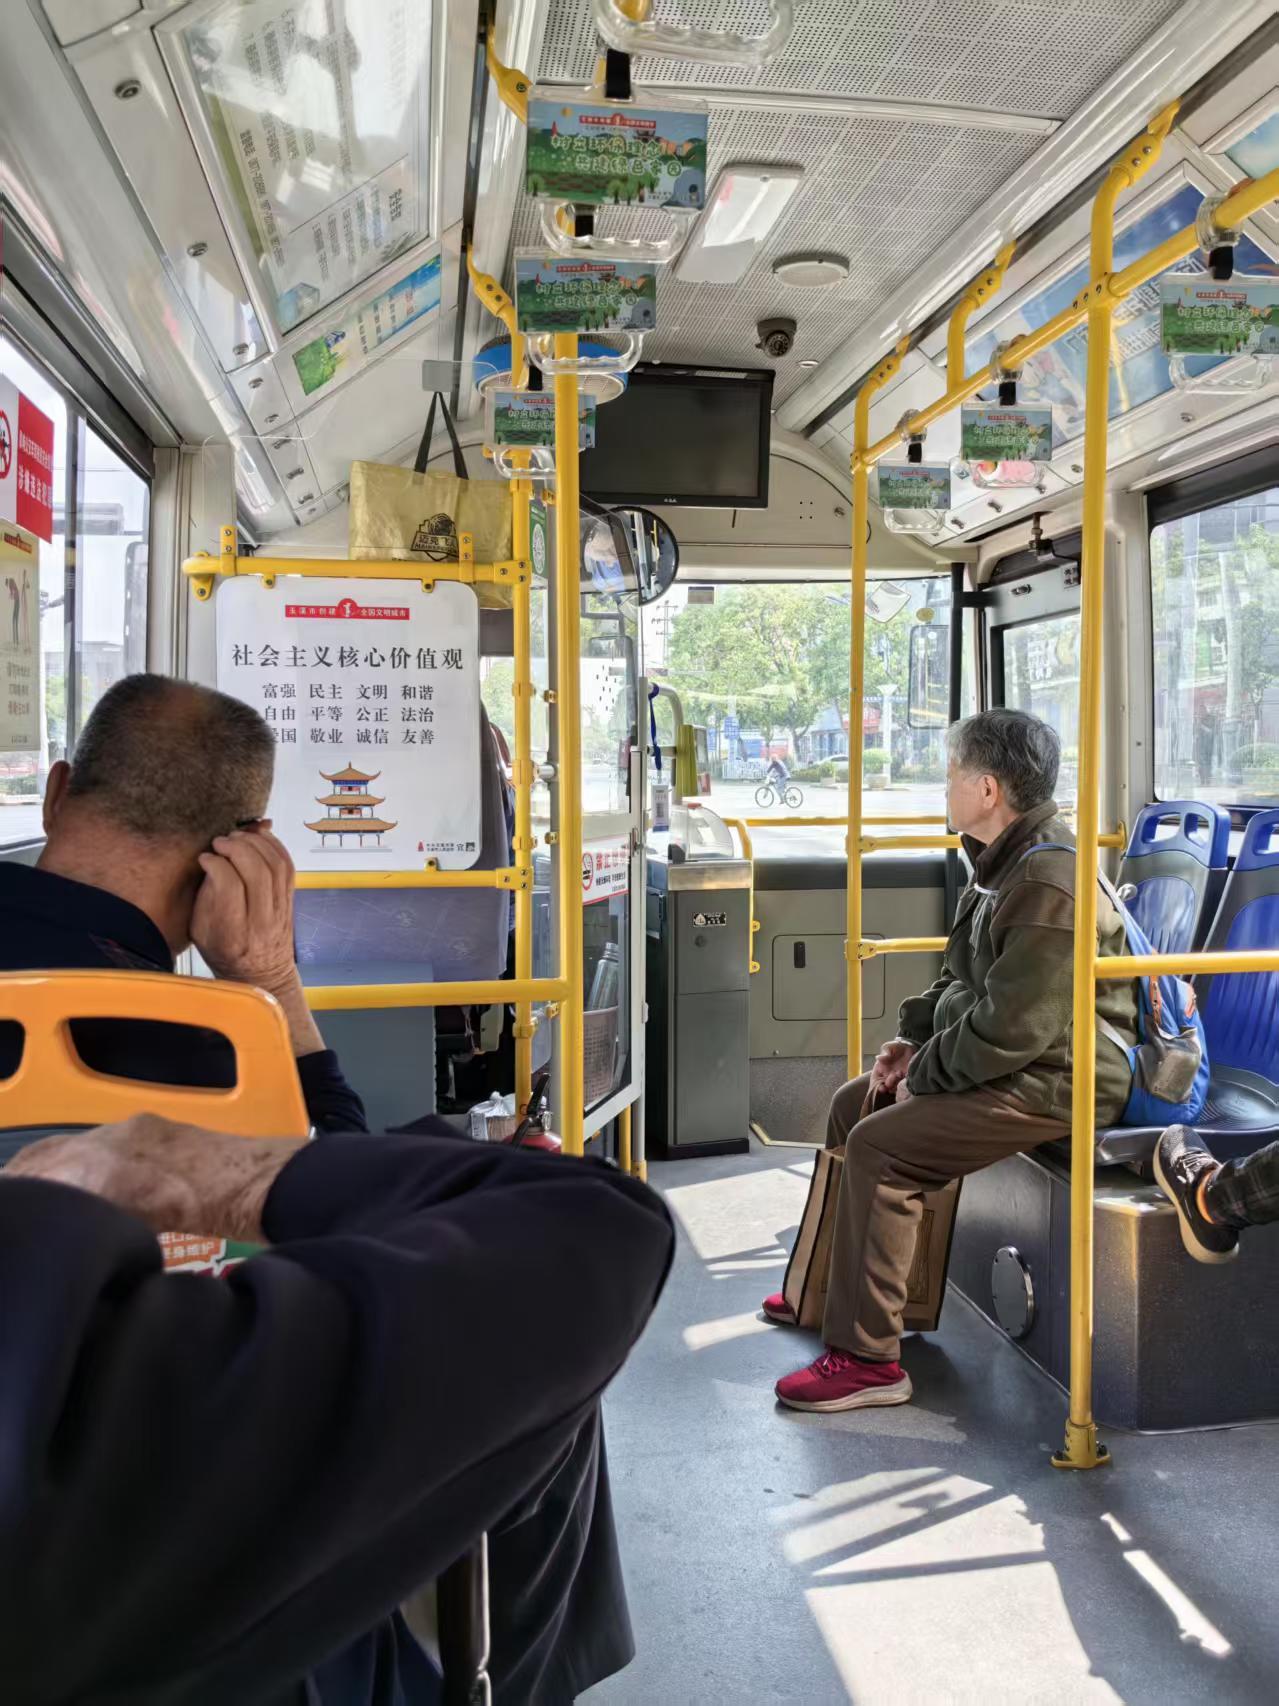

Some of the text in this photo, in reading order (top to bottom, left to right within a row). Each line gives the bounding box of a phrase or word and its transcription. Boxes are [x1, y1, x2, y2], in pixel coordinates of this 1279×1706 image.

[232, 643, 464, 671] 社会主义核心价值观
[262, 682, 434, 701] 富强 民主 文明 和谐
[264, 705, 434, 723] 自由 平等 公正 法治
[310, 728, 344, 745] 敬业
[356, 728, 389, 745] 诚信
[401, 728, 435, 745] 友善
